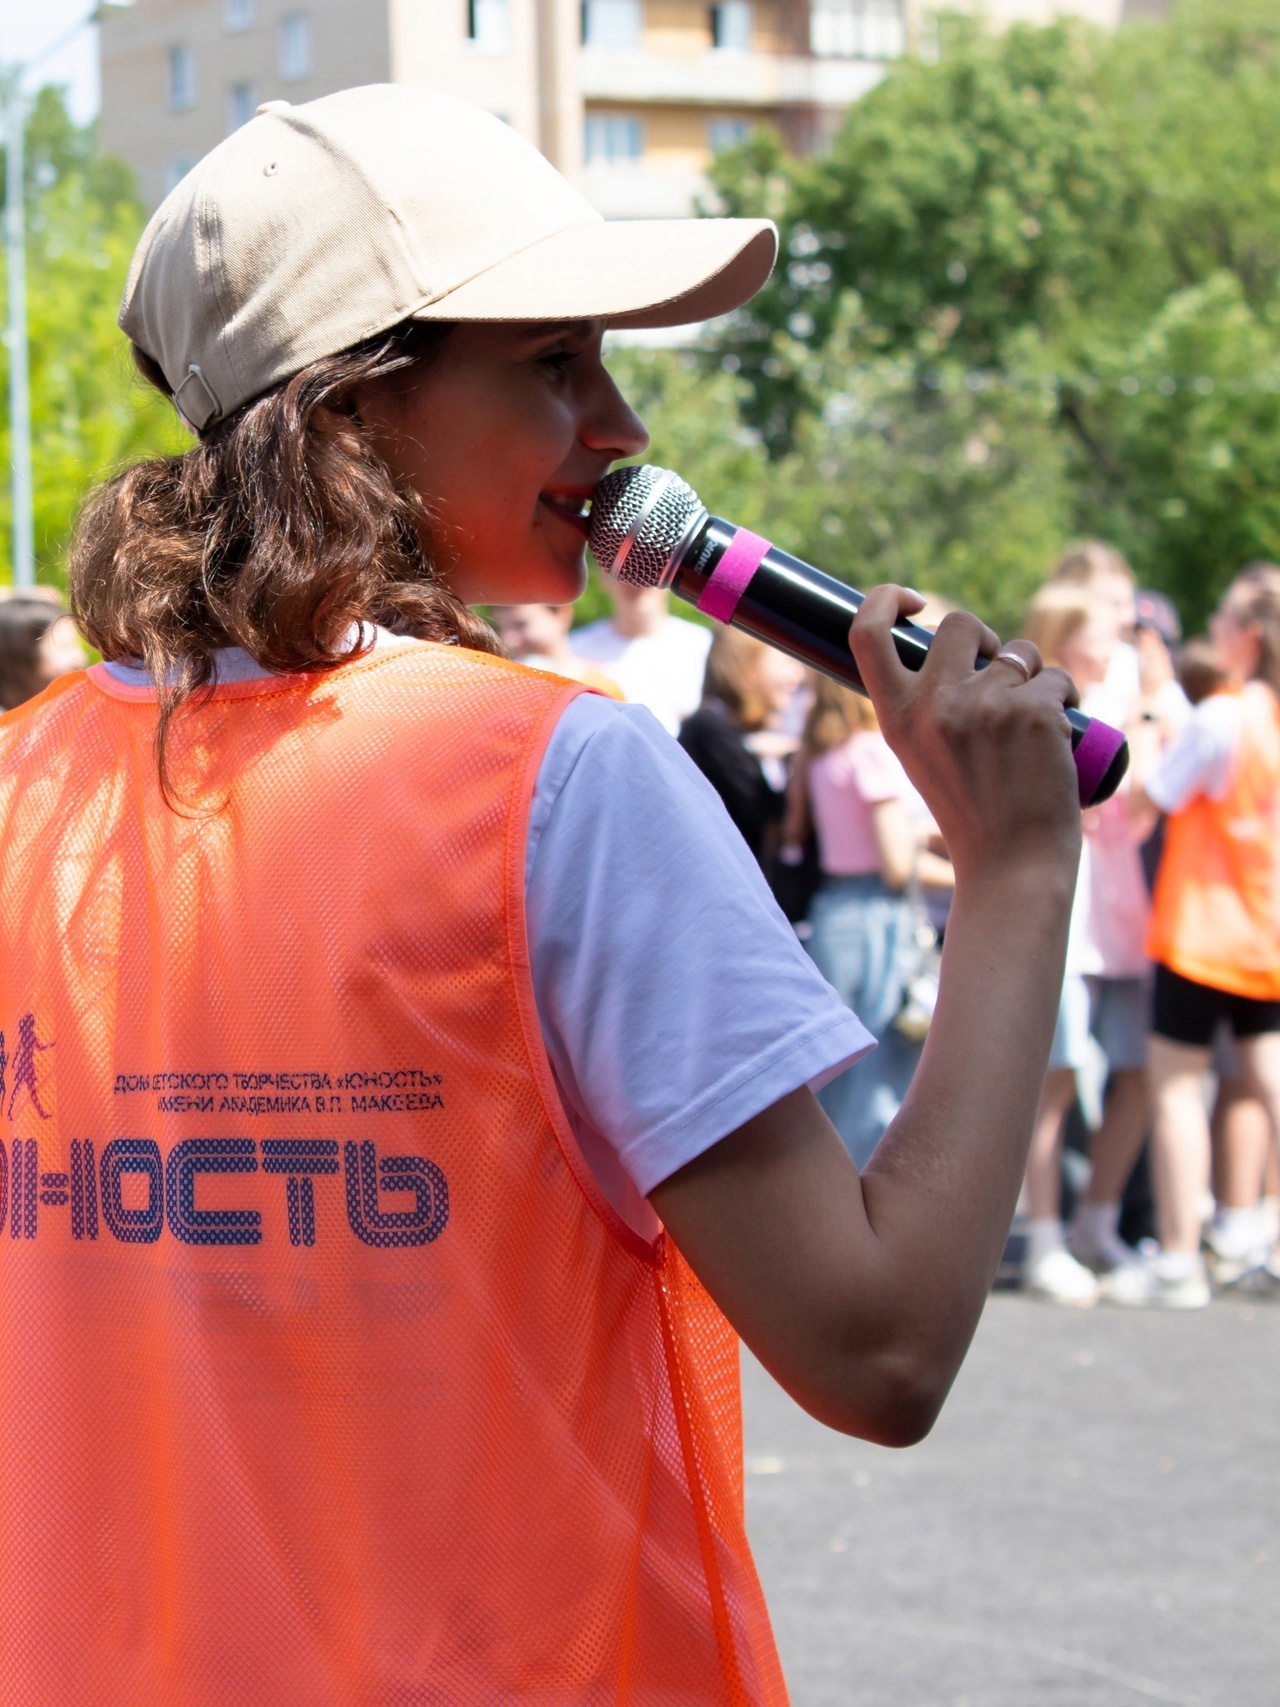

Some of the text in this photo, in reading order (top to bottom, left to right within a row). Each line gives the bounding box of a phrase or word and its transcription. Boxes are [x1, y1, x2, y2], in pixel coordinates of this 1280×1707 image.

[694, 538, 720, 574] SHUR
[114, 1074, 150, 1094] ДОМ
[232, 1073, 332, 1090] ТВОРЧЕСТВА
[337, 1070, 443, 1089] «ЮНОСТЬ»
[158, 1096, 214, 1112] ИМЕНИ
[220, 1096, 311, 1115] АКАДЕМИКА
[351, 1093, 445, 1112] МАКЕЕВА
